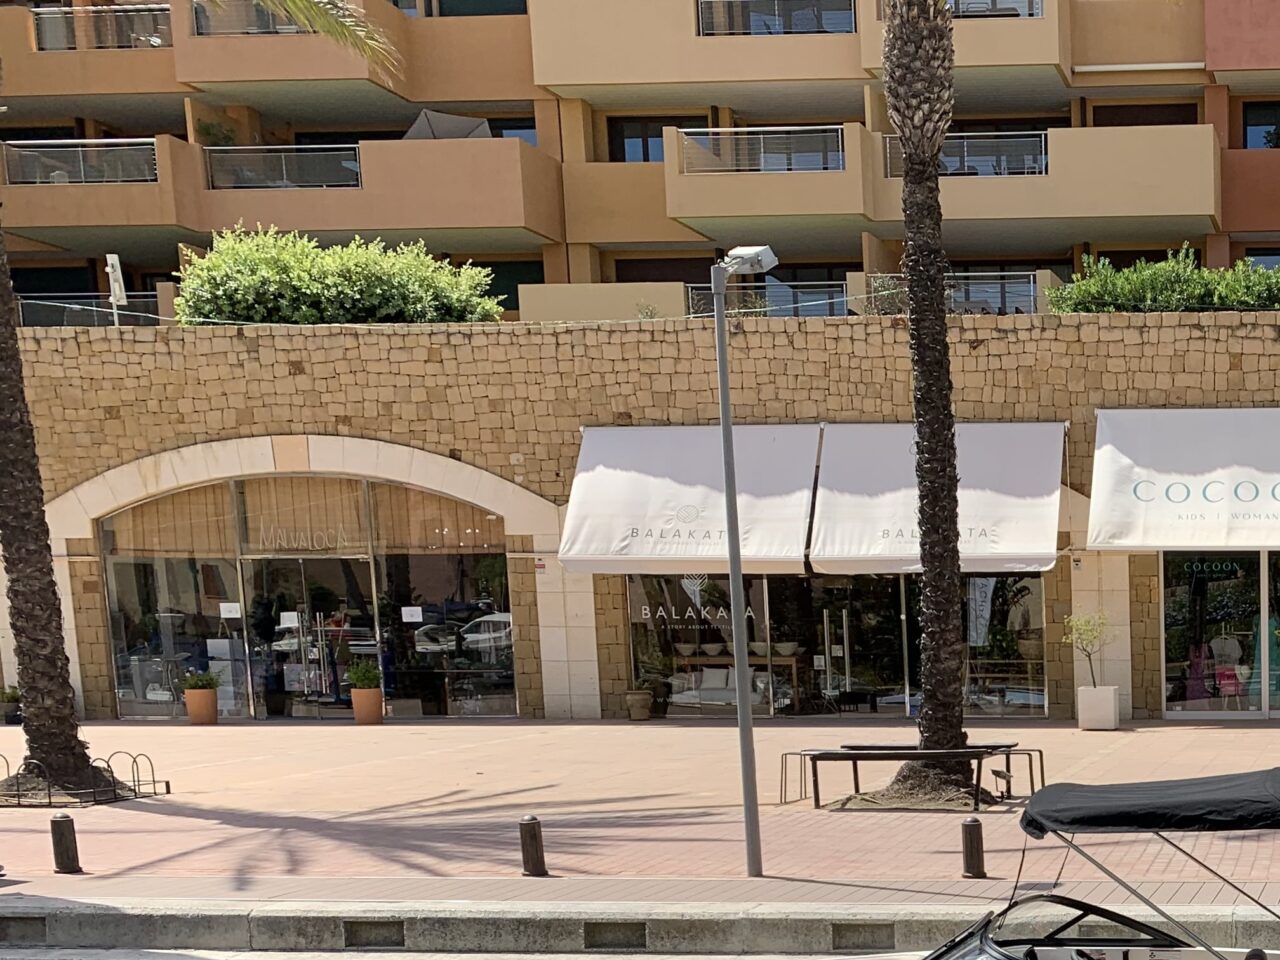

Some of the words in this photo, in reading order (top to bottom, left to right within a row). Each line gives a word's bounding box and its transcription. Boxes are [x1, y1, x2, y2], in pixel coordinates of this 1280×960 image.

[1177, 513, 1206, 521] KIDS
[1231, 512, 1280, 521] WOMAN
[631, 528, 727, 540] BALAKAT
[1183, 562, 1240, 572] COCOON
[641, 605, 756, 620] BALAKAA
